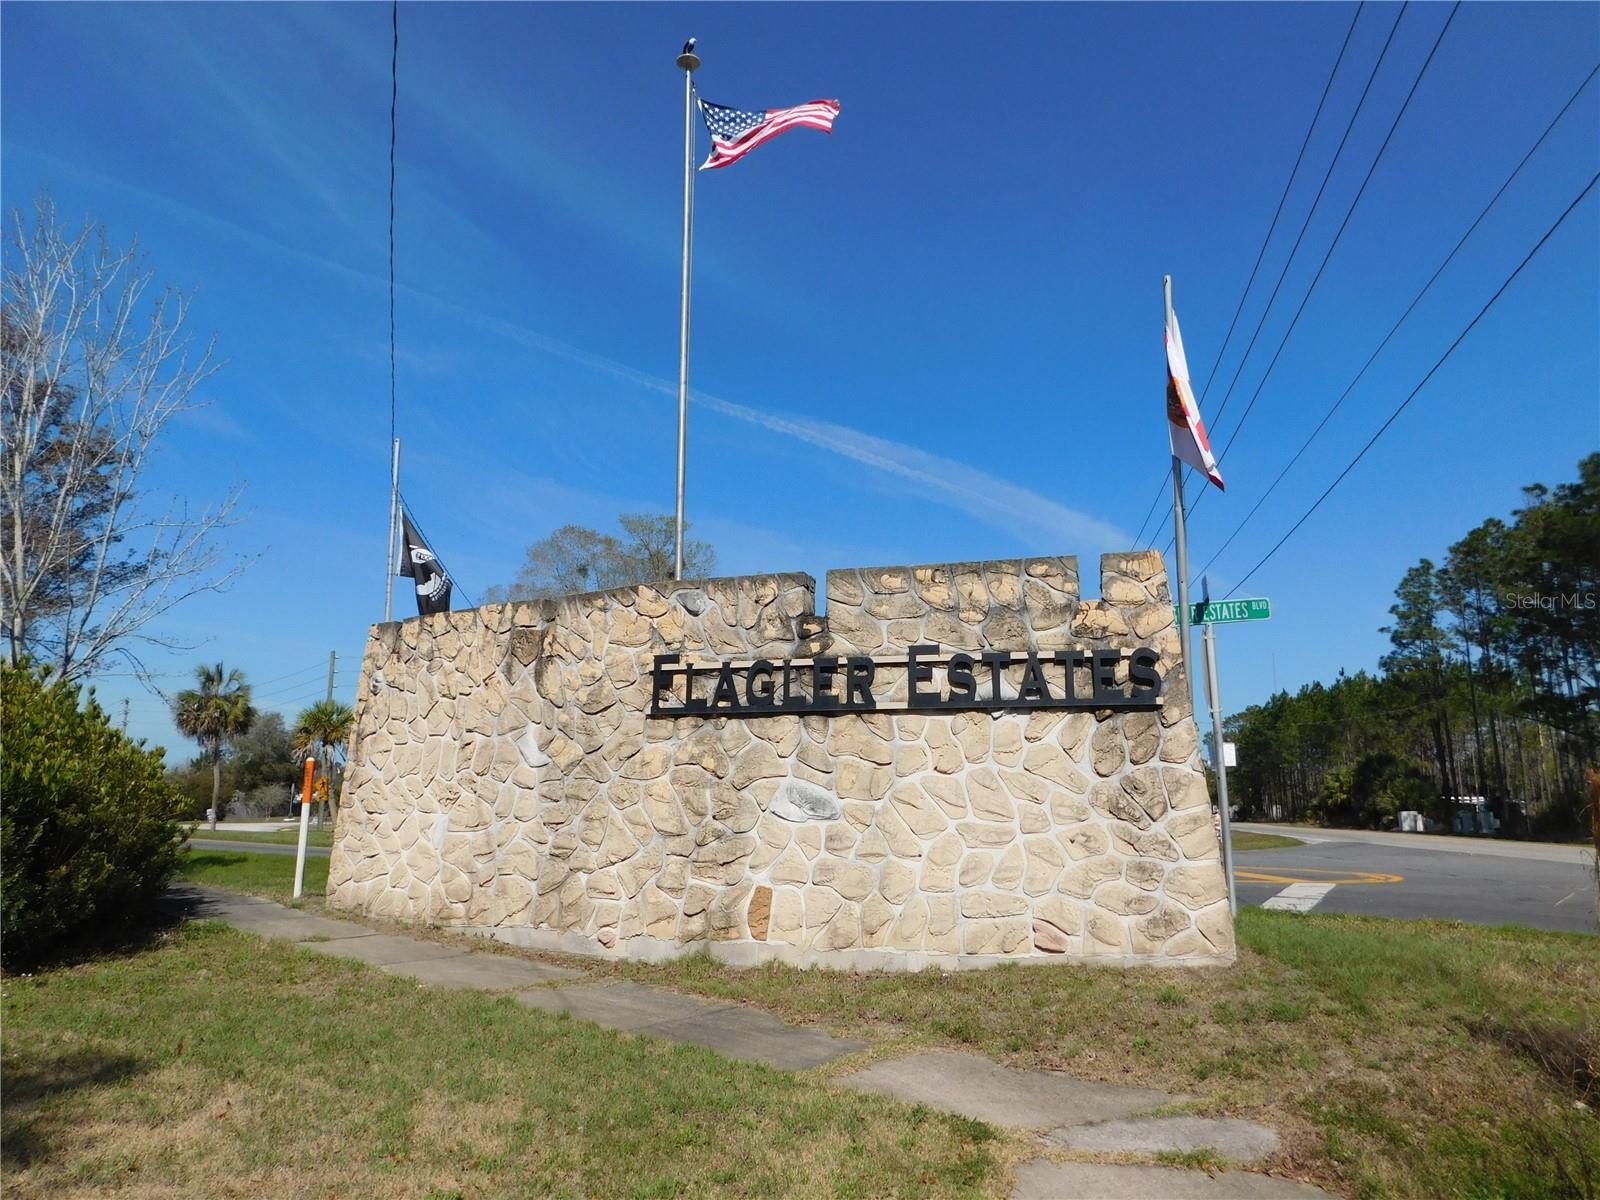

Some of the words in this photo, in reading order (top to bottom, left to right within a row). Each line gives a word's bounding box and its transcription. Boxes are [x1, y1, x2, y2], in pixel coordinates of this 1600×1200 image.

[1251, 600, 1267, 610] BLVD
[652, 654, 876, 713] FLAGLER
[907, 645, 1162, 709] ESTATES
